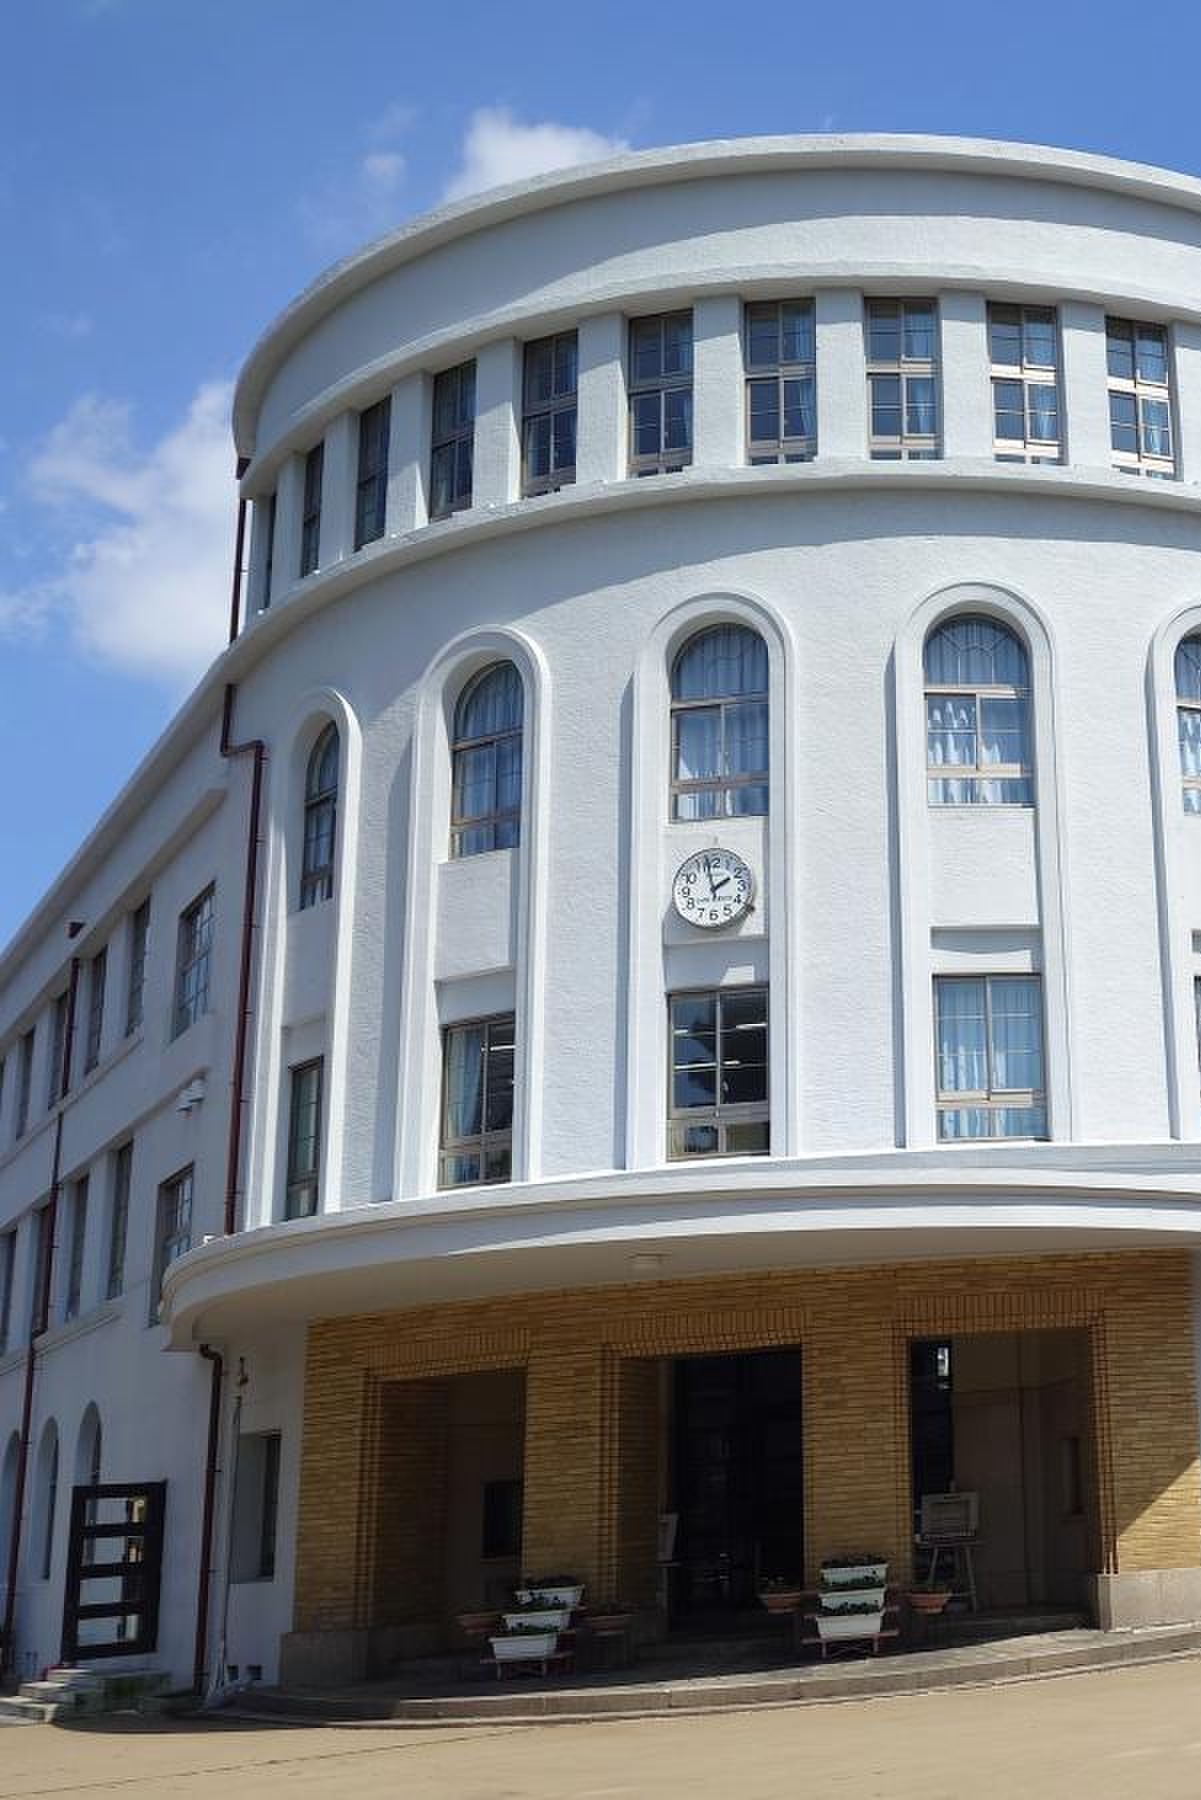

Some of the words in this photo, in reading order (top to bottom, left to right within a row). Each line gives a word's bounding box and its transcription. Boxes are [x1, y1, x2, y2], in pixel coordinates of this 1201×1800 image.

[681, 873, 697, 884] 10
[734, 867, 743, 879] 2
[737, 879, 747, 892] 3
[681, 886, 690, 898] 9
[686, 897, 695, 910] 8
[697, 907, 705, 918] 7
[709, 909, 719, 921] 6
[723, 904, 732, 916] 5
